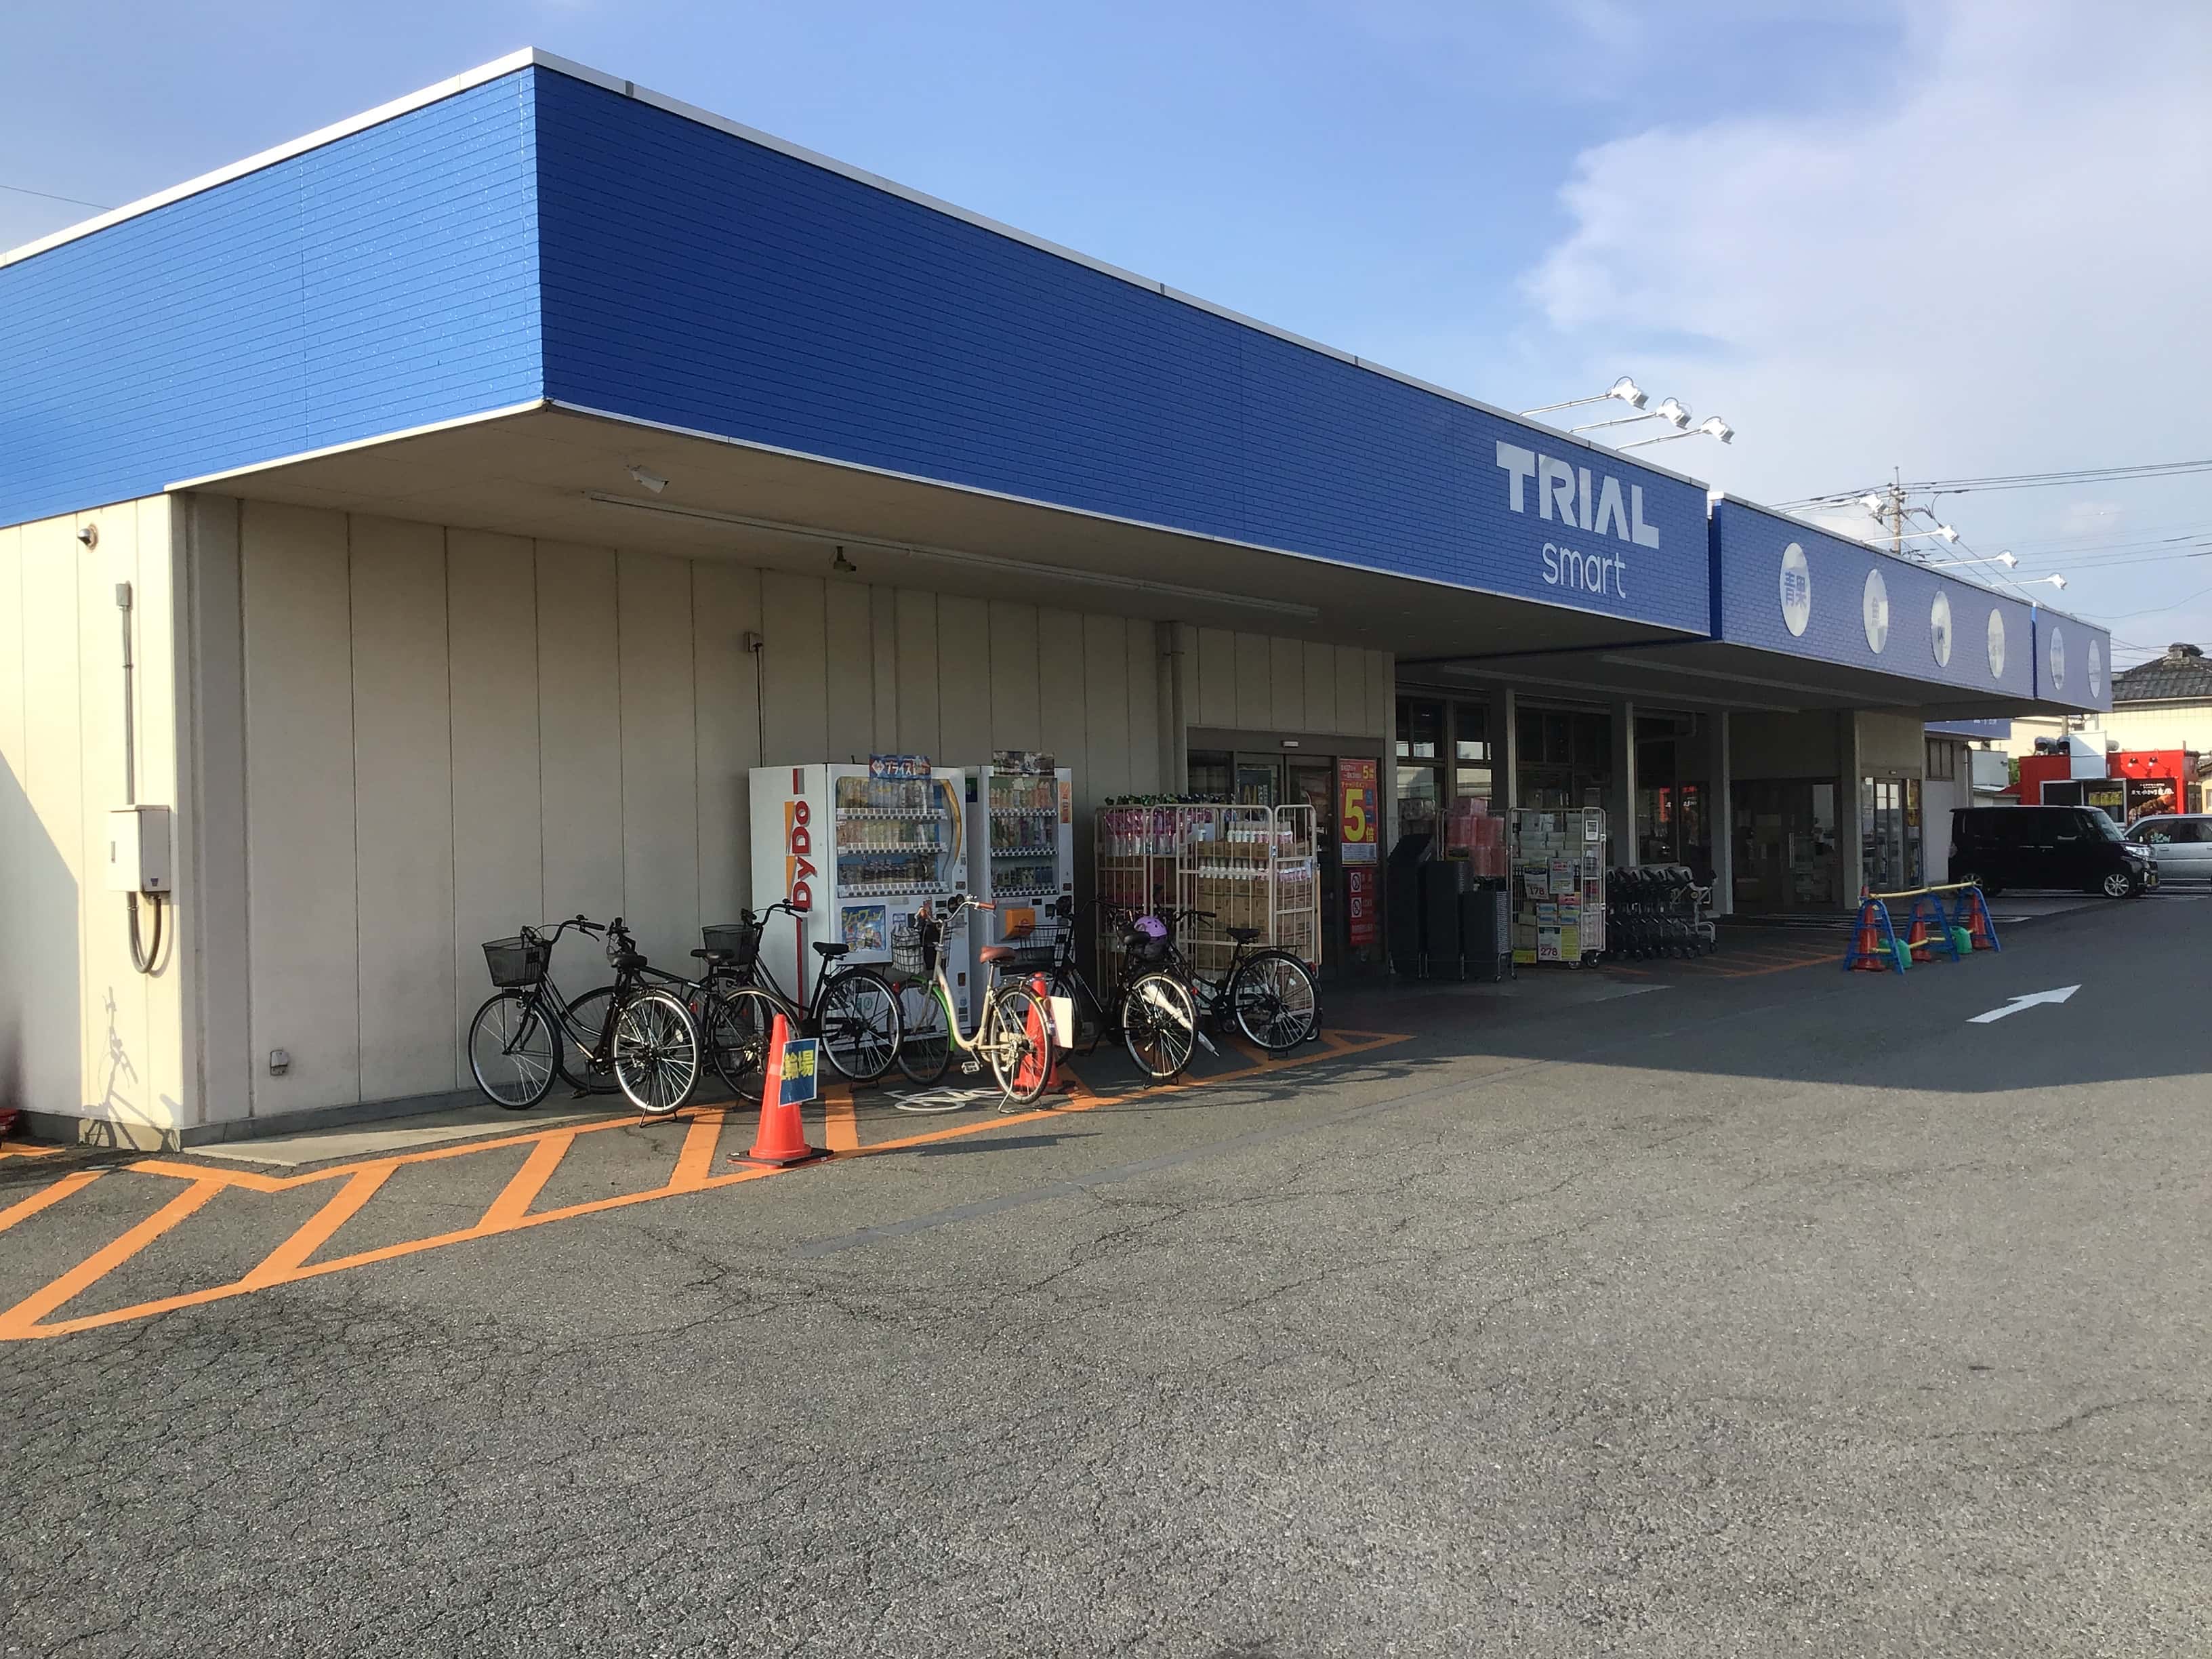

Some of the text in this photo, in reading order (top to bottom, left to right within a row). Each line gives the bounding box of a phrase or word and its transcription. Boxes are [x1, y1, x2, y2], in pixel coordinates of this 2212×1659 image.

[1496, 440, 1660, 549] TRIAL
[1542, 542, 1626, 598] smart
[1784, 571, 1807, 609] 青果
[792, 800, 817, 911] DyDo
[1540, 947, 1558, 956] 278
[781, 1050, 815, 1081] 輪場
